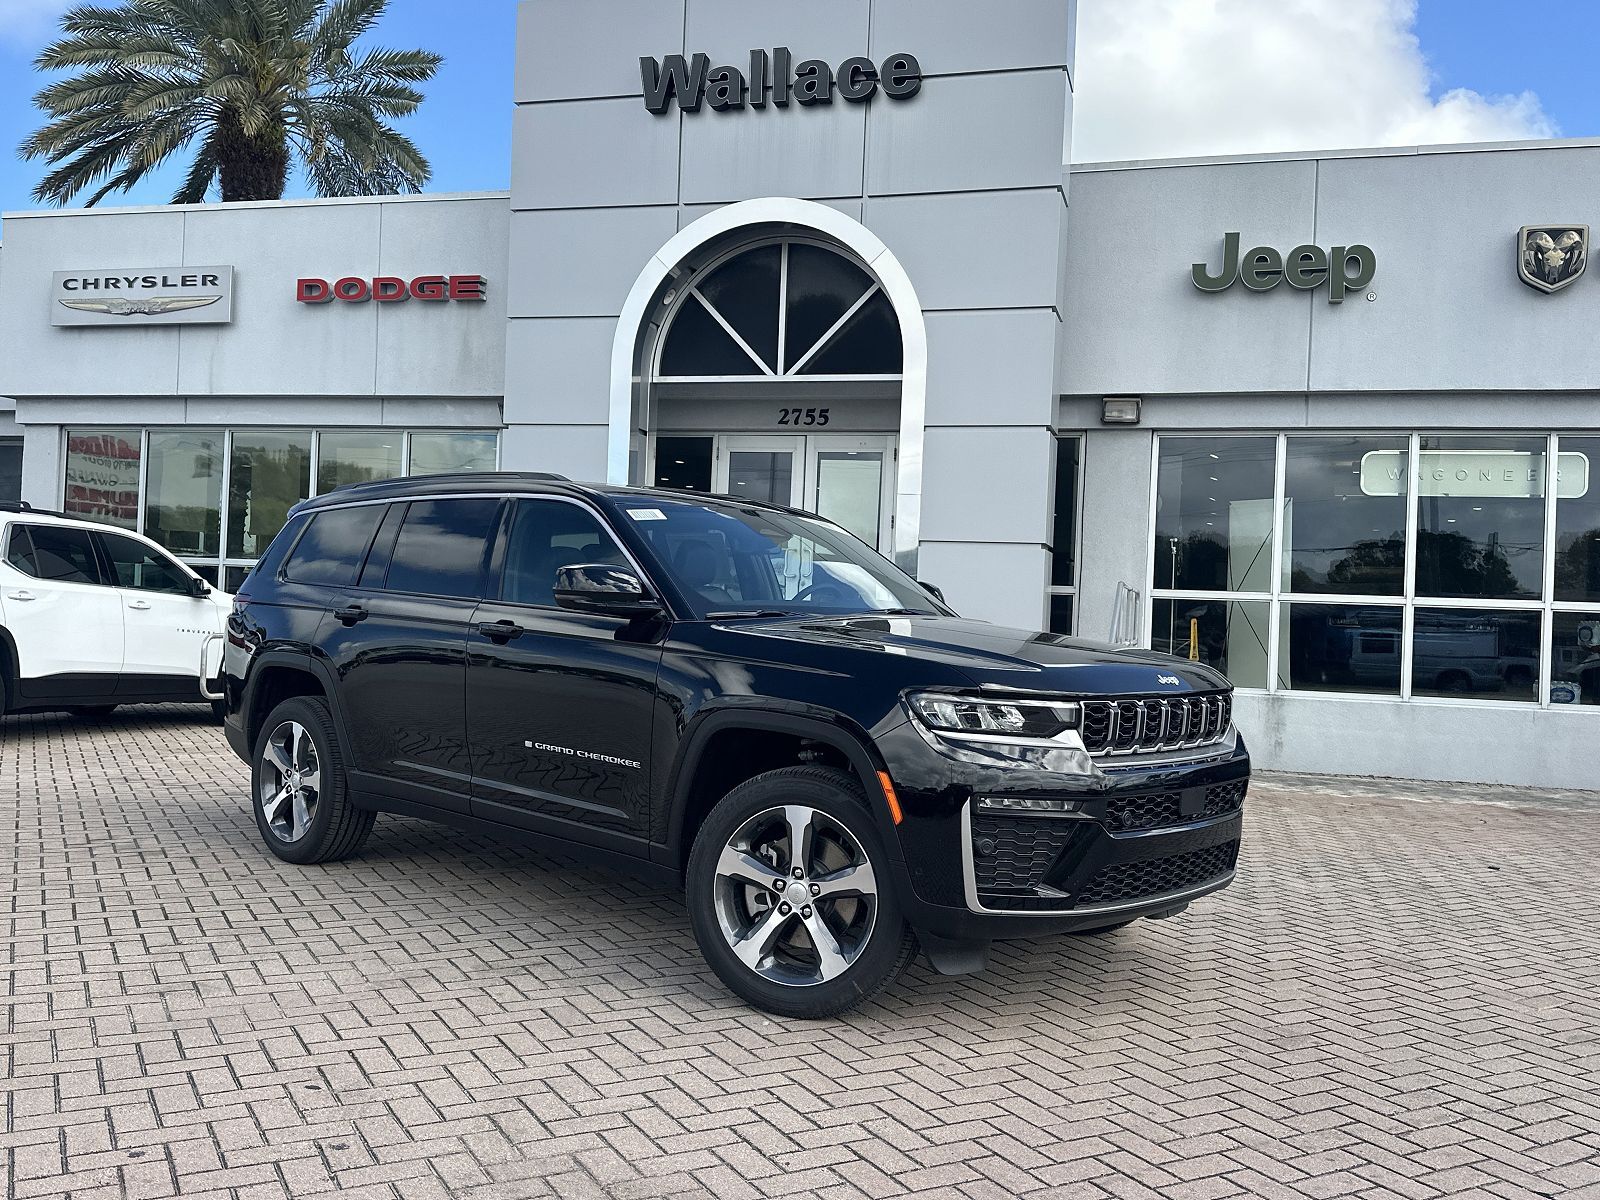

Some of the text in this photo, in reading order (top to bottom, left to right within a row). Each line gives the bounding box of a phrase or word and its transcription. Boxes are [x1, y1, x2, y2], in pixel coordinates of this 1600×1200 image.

[638, 47, 922, 115] Wallace
[1191, 231, 1377, 304] Jeep
[62, 274, 220, 291] CHRYSLER
[296, 274, 487, 303] DODGE
[777, 407, 830, 426] 2755
[1157, 674, 1180, 686] Jeep
[534, 742, 641, 769] GRAND CHEROKEE
